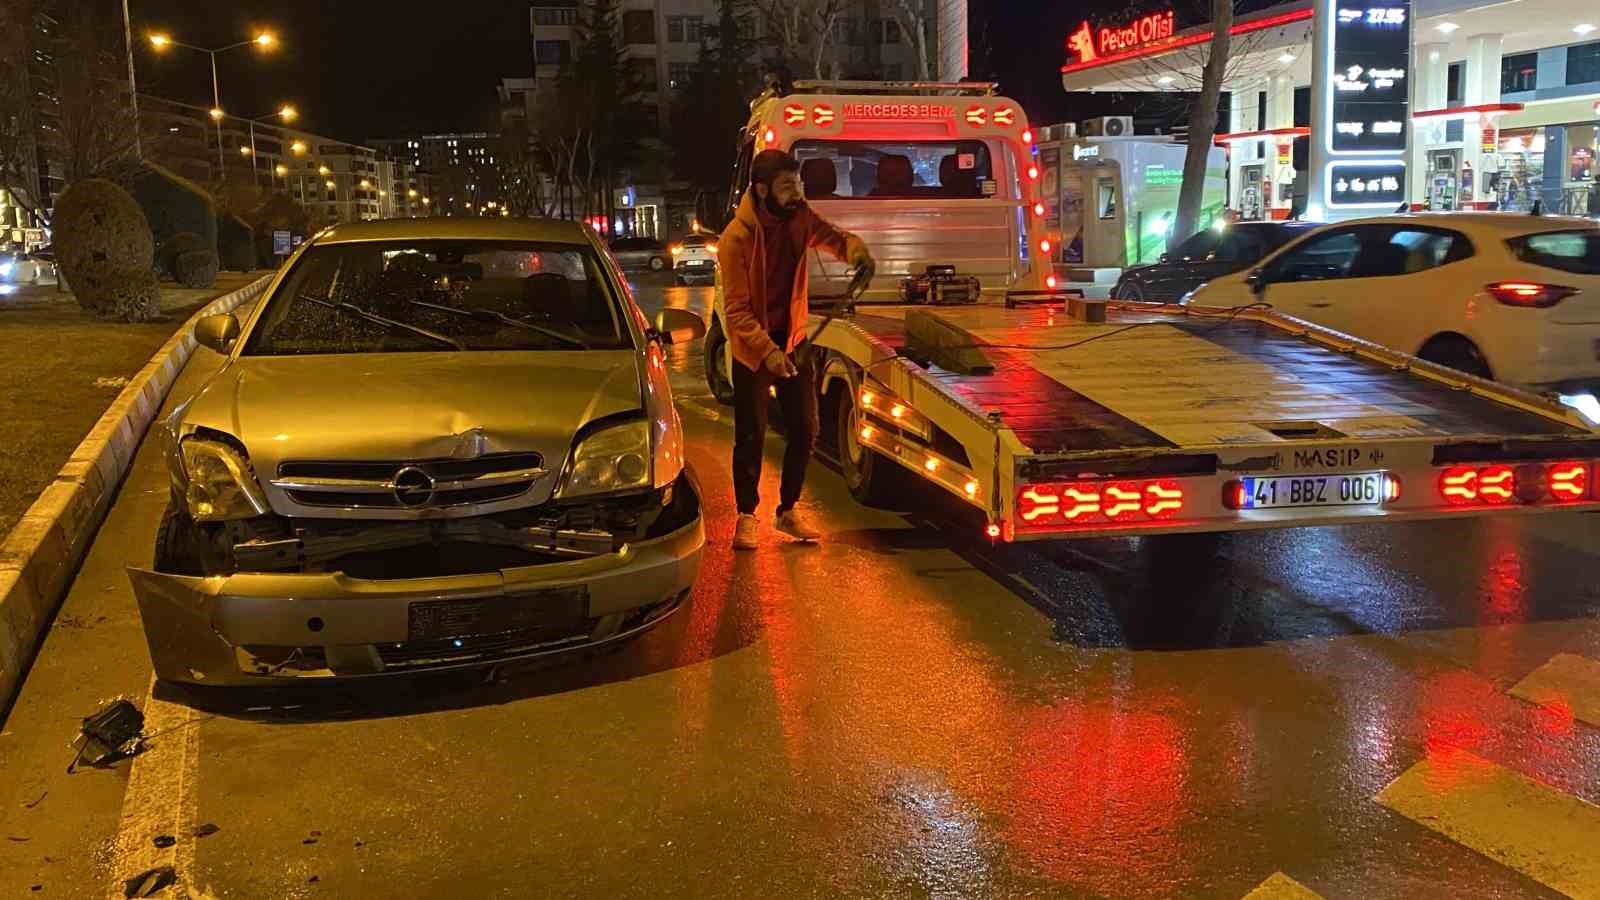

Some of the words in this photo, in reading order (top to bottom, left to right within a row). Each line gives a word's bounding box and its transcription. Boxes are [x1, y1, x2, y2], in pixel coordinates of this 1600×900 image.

[1101, 20, 1138, 52] Petrol
[1140, 10, 1173, 42] Ofisi
[844, 103, 918, 117] MERCEDES
[1255, 480, 1277, 504] 41
[1290, 478, 1328, 503] BBZ
[1340, 476, 1375, 501] 006
